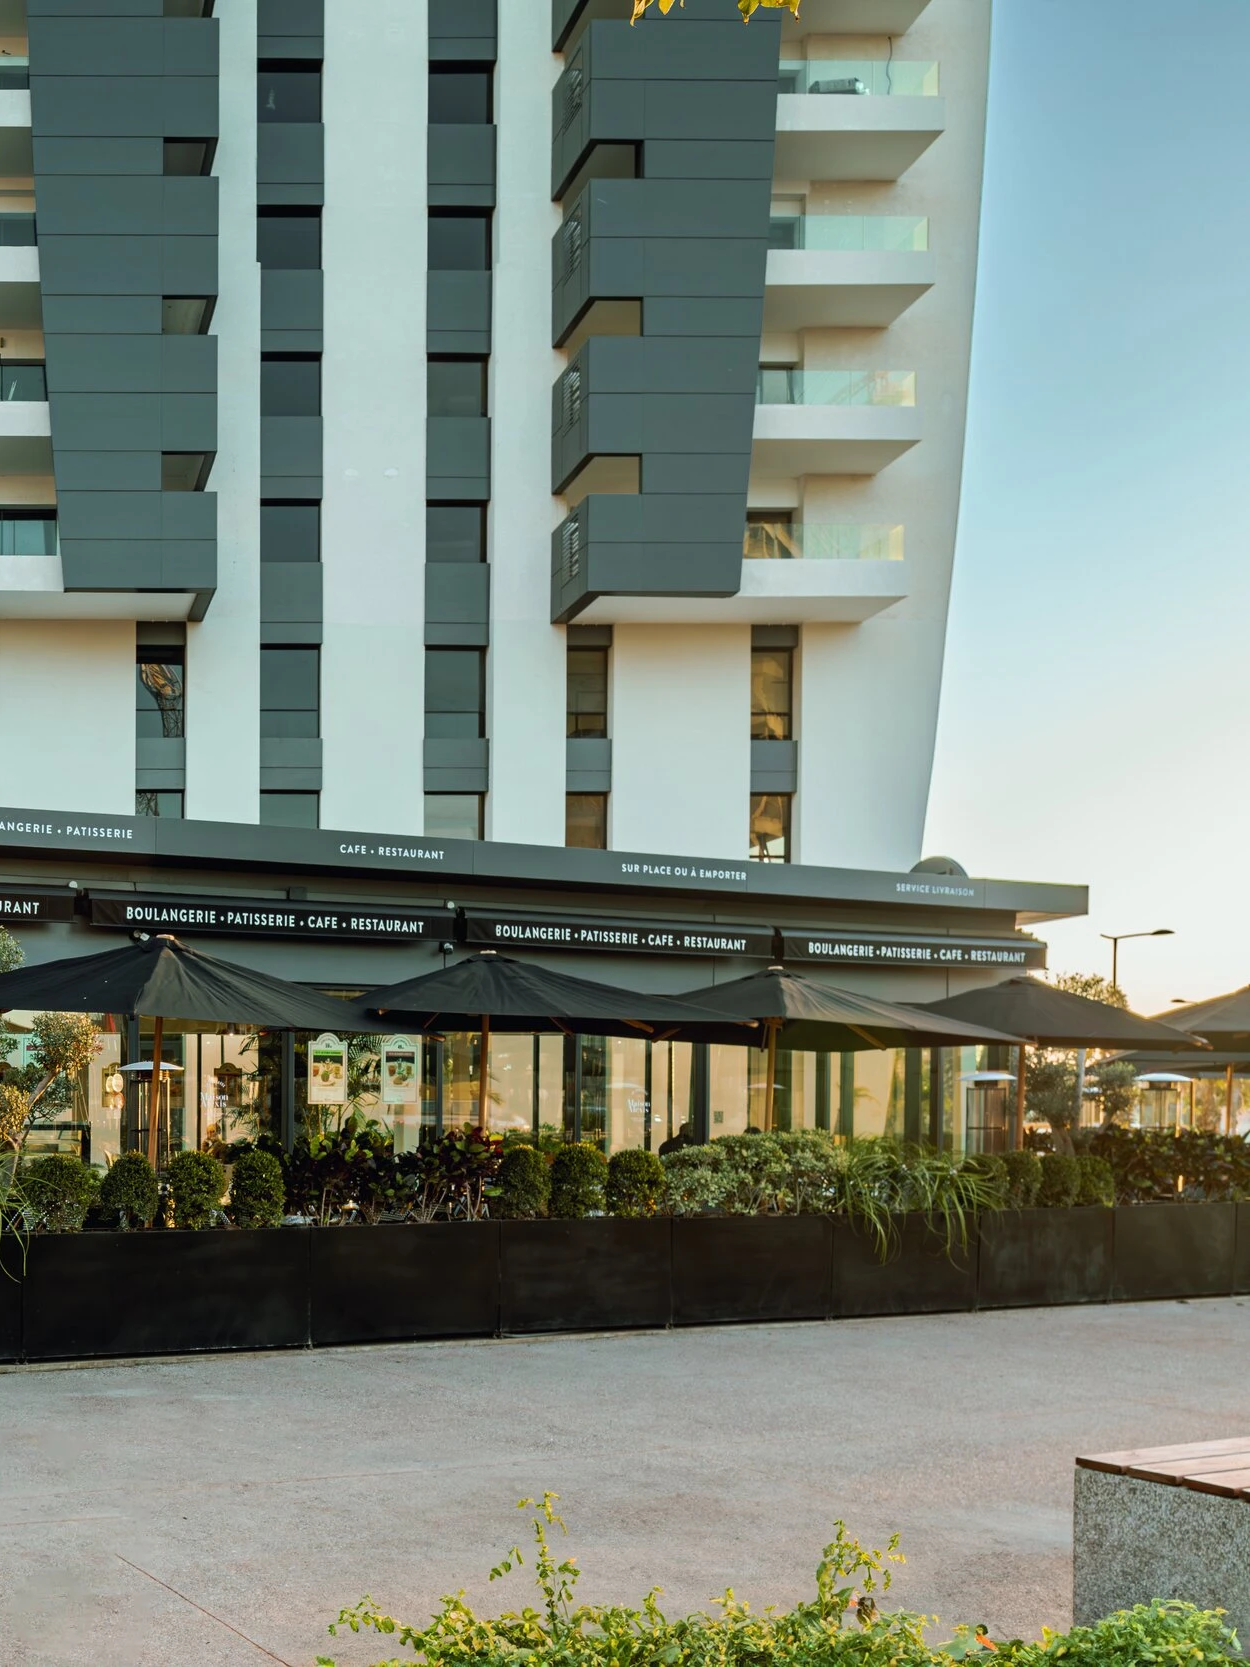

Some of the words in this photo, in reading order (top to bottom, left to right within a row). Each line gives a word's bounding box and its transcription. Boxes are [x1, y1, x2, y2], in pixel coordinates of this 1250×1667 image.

[65, 825, 134, 839] PATISSERIE
[338, 843, 368, 854] CAFE
[377, 846, 446, 860] RESTAURANT
[620, 863, 641, 872] SUR
[643, 864, 672, 875] PLACE
[674, 866, 689, 876] OU
[690, 866, 697, 877] À
[699, 868, 748, 881] EMPORTER
[895, 883, 931, 893] SERVICE
[931, 886, 975, 896] LIVRAISON
[125, 905, 217, 924] BOULANGERIE
[226, 911, 297, 928] PATISSERIE
[306, 915, 339, 929] CAFE
[349, 917, 425, 934] RESTAURANT
[494, 924, 572, 941] BOULANGERIE
[579, 929, 640, 945] PATISSERIE
[646, 934, 675, 947] CAFE
[682, 935, 748, 951] RESTAURANT
[807, 941, 874, 958] BOULANGERIE
[880, 945, 932, 960] PATISSERIE
[938, 948, 963, 961] CAFE
[969, 951, 1027, 963] RESTAURANT
